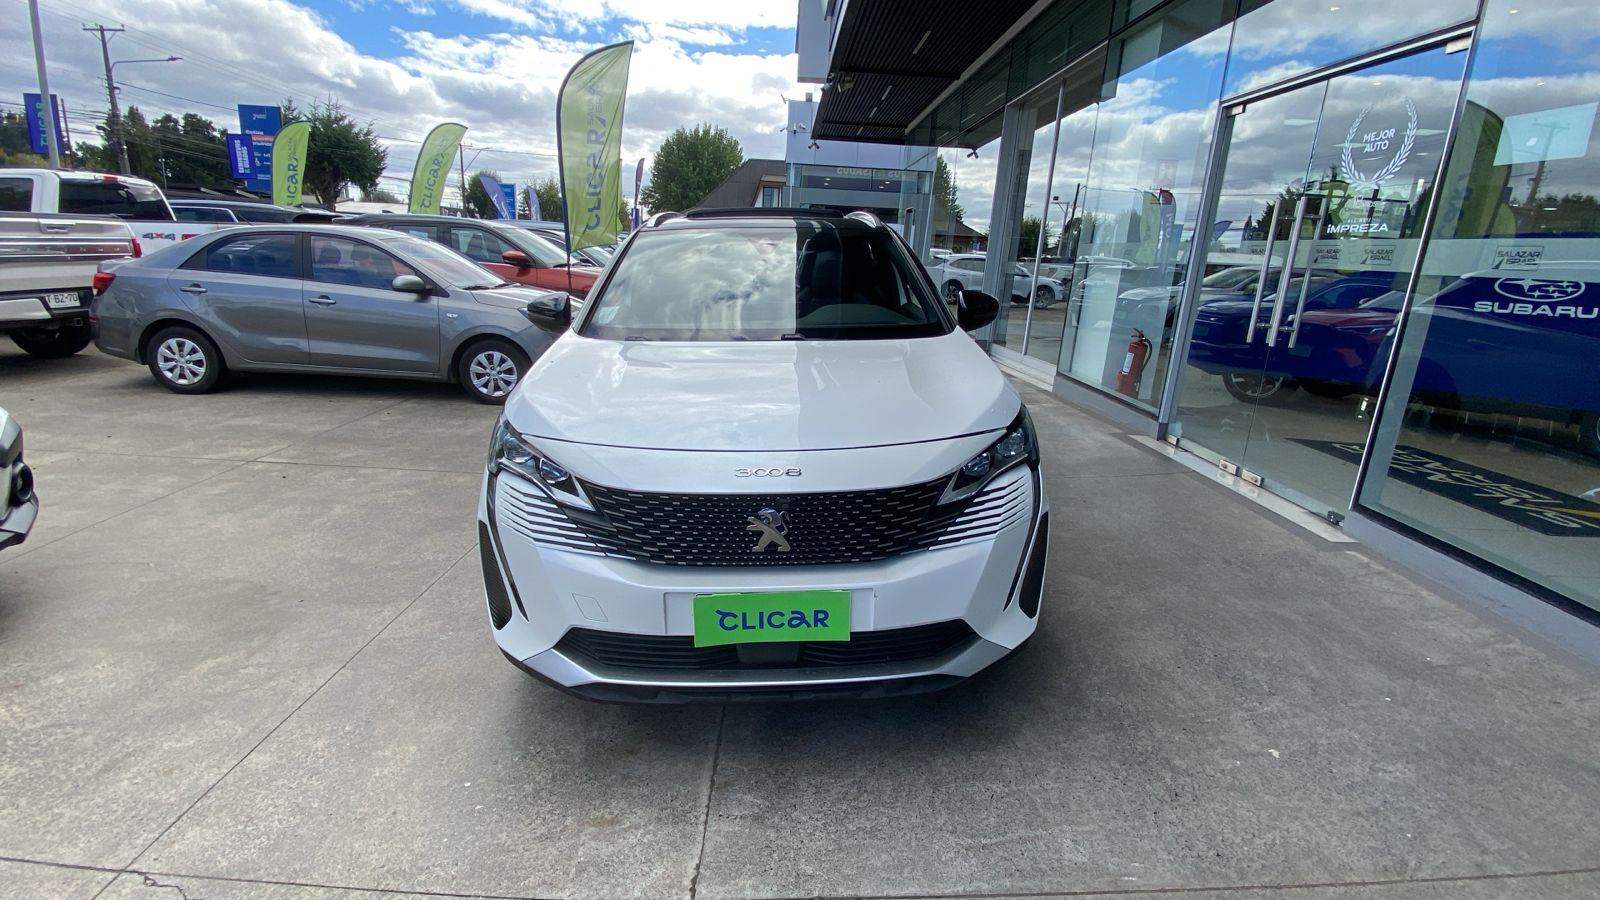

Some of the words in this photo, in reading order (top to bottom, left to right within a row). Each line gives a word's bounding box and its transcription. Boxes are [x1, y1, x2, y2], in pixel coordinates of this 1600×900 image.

[1363, 128, 1396, 143] MEJOR
[1363, 141, 1390, 153] AUTO
[1497, 250, 1542, 258] SALAZAR
[1473, 301, 1599, 319] SUBARU
[734, 466, 803, 478] 3008
